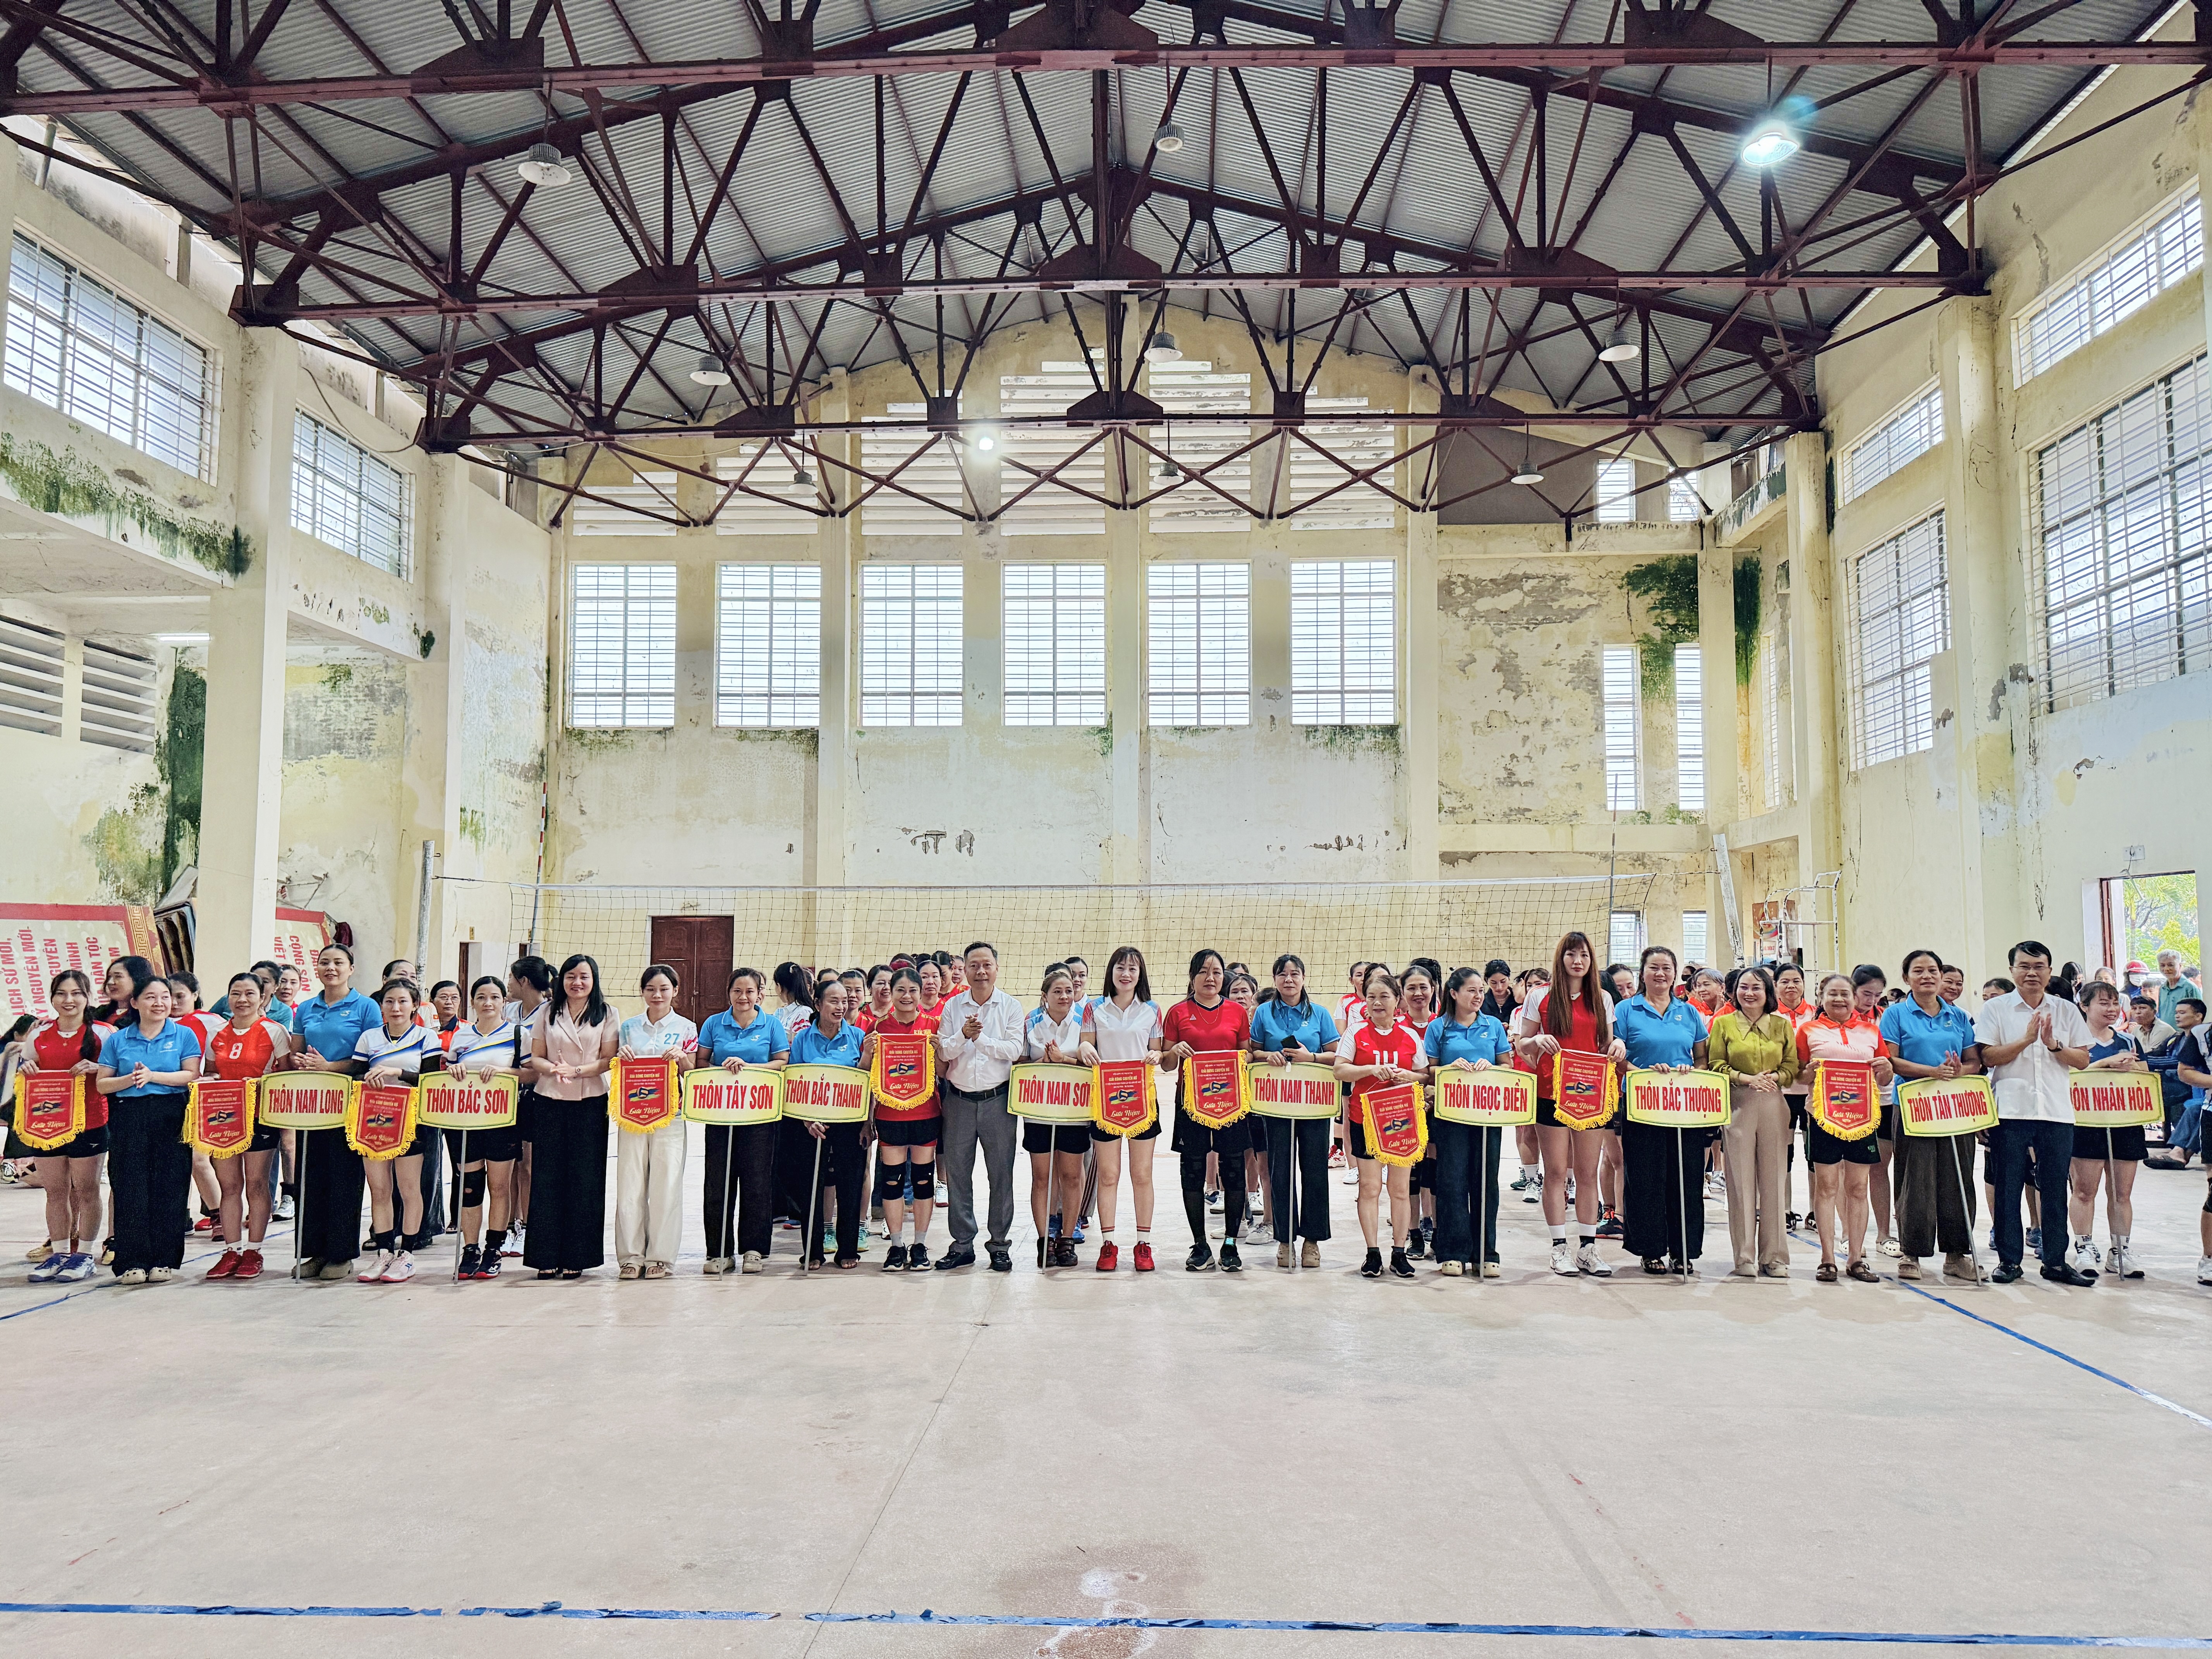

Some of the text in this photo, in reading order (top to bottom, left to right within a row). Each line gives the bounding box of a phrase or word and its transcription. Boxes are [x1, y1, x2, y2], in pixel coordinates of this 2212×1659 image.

[43, 939, 62, 979] GUYÊN
[85, 937, 101, 958] TỘC
[289, 935, 305, 965] CỘNG
[24, 956, 46, 1004] NGUYÊN
[229, 1042, 243, 1060] 8
[663, 1033, 680, 1045] 27
[268, 1084, 344, 1114] THÔN NAM LONG
[427, 1081, 509, 1114] THÔN BẮC SƠN
[693, 1079, 774, 1110] THÔN TÂY SƠN
[786, 1073, 863, 1109] THÔN BẮC THANH
[1018, 1075, 1044, 1104] THÔN
[1046, 1081, 1070, 1106] NAM
[1254, 1073, 1335, 1105] THÔN NAM THANH
[1443, 1079, 1528, 1116] THÔN NGỌC ĐIỀN
[1635, 1079, 1722, 1118] THÔN BẮC THƯỢNG
[2070, 1080, 2153, 1111] ÔN NHÂN HÒA
[1907, 1090, 1988, 1122] THÔN TÂN THƯỢNG
